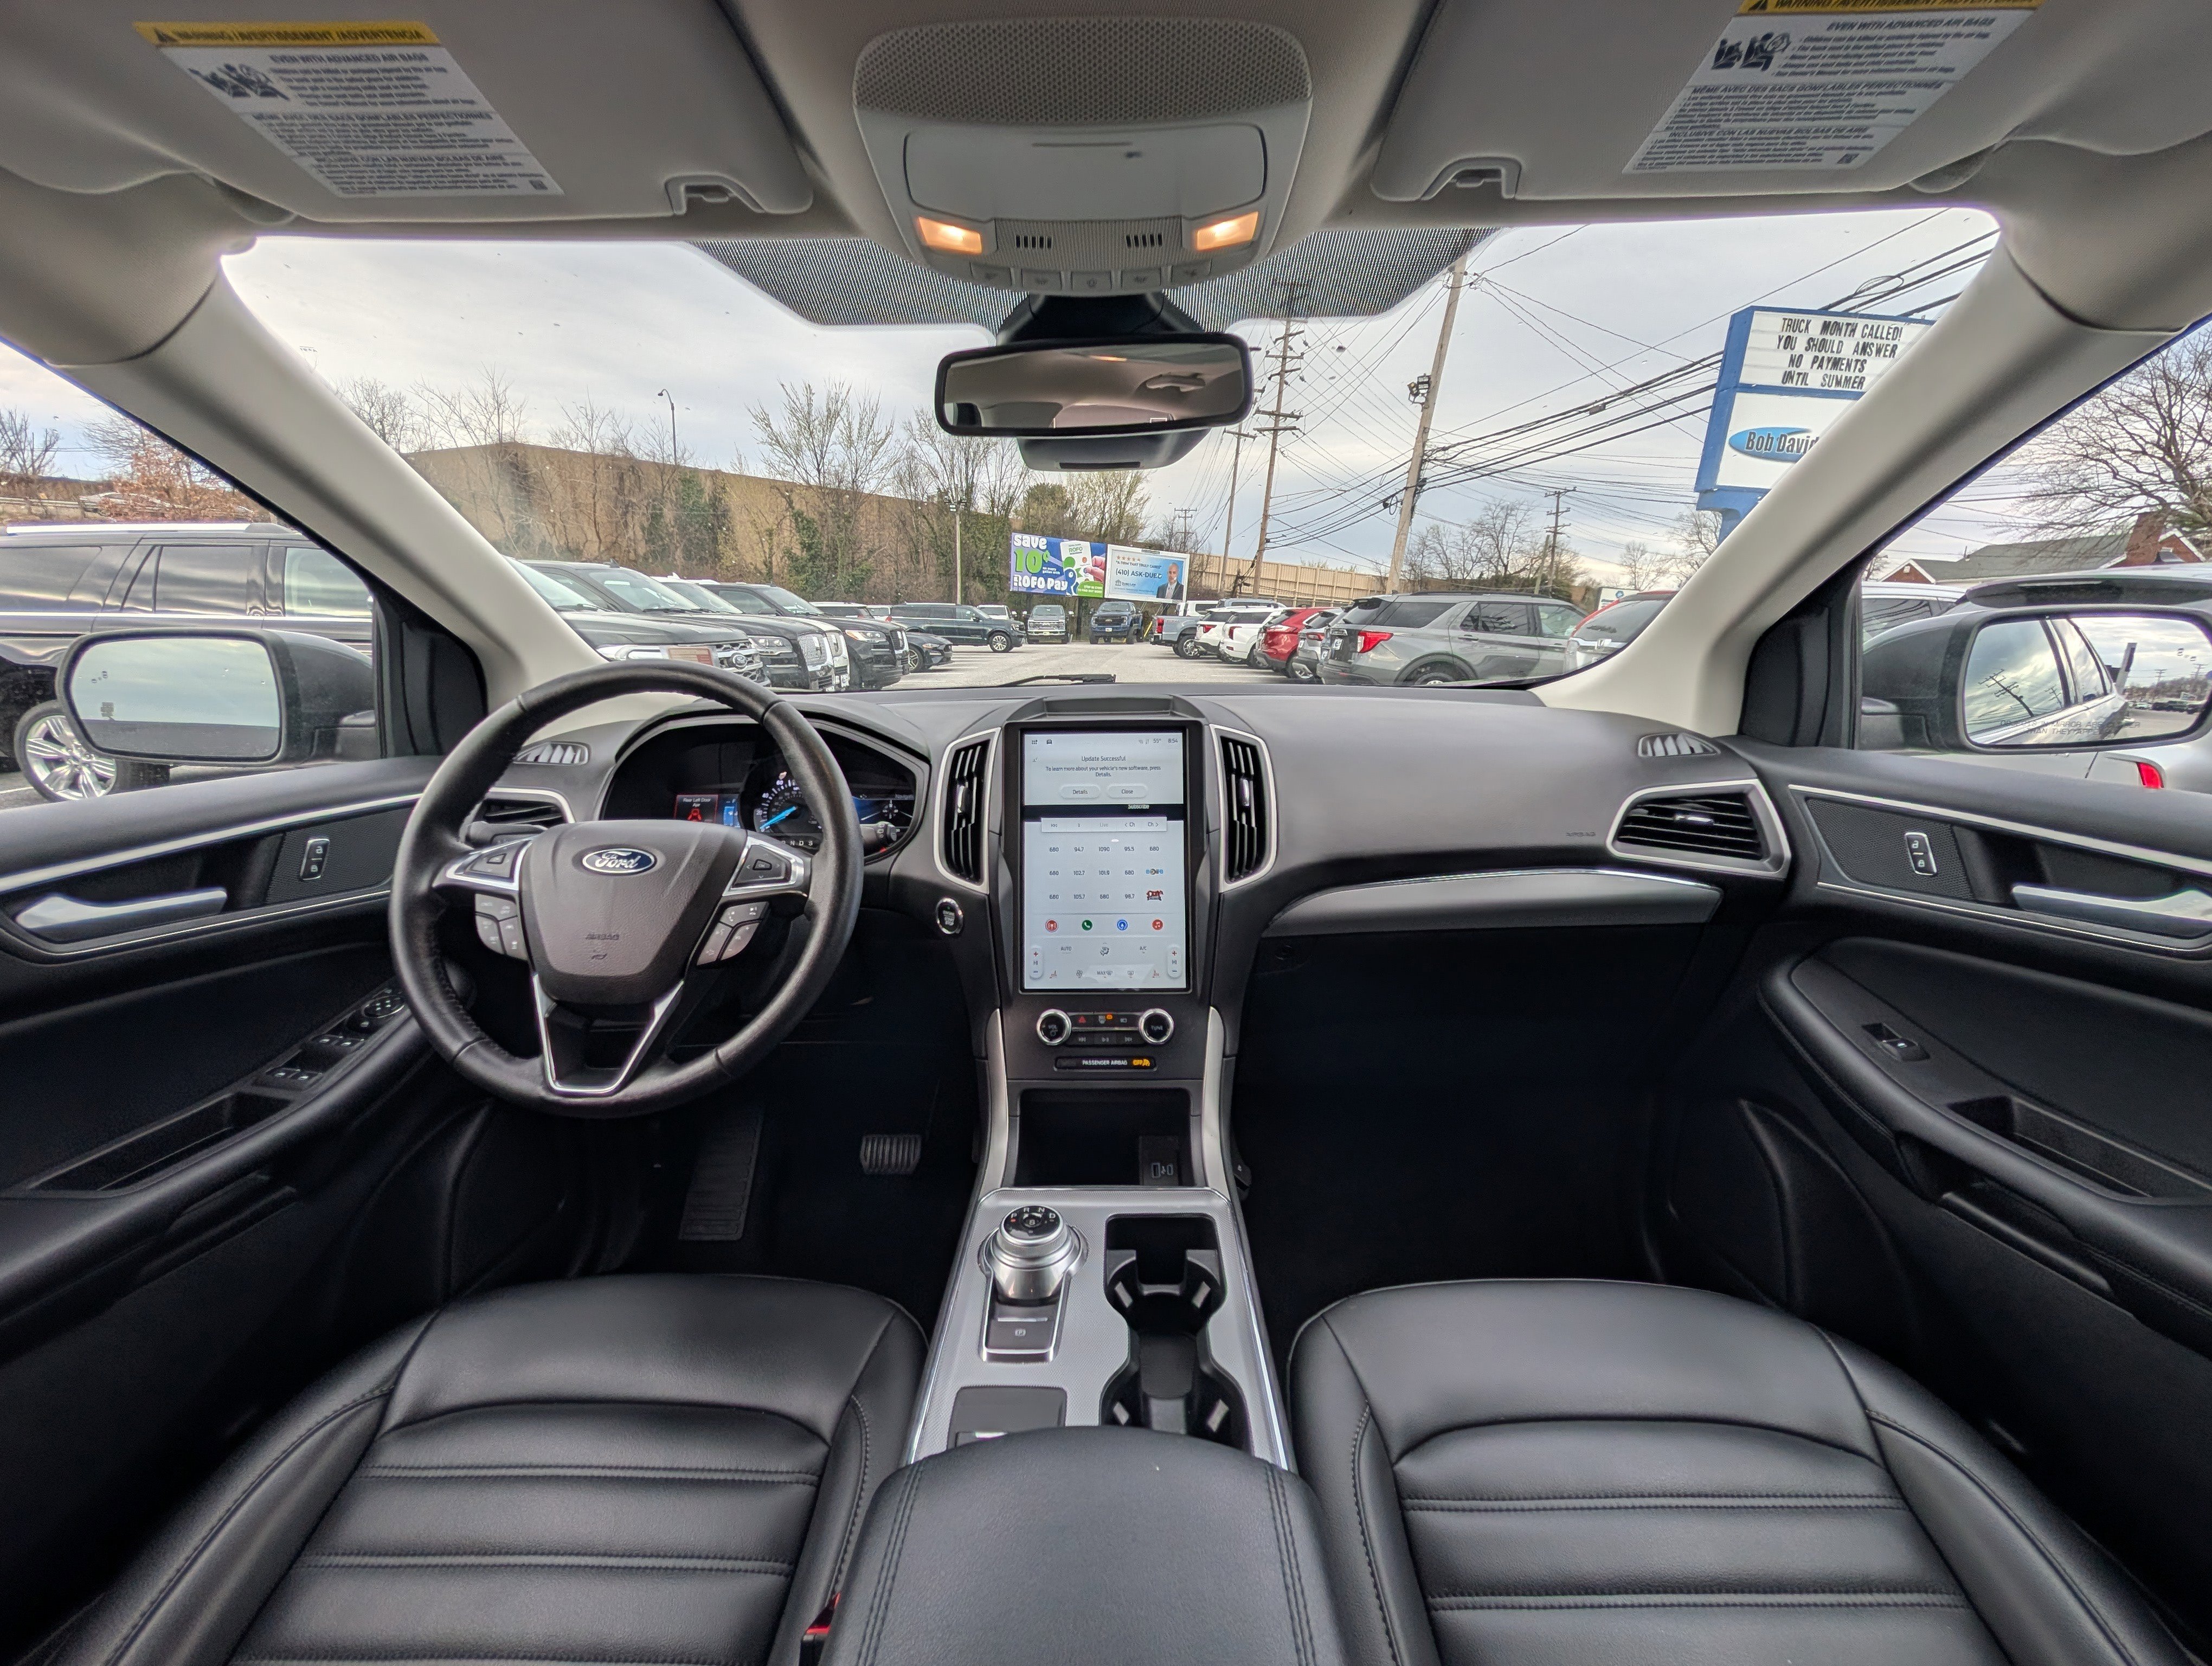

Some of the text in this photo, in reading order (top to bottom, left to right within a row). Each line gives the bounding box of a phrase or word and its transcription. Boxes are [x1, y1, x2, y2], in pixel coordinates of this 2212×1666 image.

[1825, 22, 1859, 30] EVEN
[1856, 21, 1887, 30] WITH
[1883, 18, 1945, 29] ADVANCED
[1961, 17, 1997, 27] BAGS
[1781, 318, 1902, 341] TRUCK MONTH CALLED!
[1777, 335, 1898, 358] YOU SHOULD ANSWER
[1788, 354, 1867, 373] NO PAYMENTS
[1782, 370, 1866, 389] UNTIL SUMMER
[1746, 432, 1772, 453] Bob
[1013, 574, 1046, 589] ROFO
[1116, 568, 1129, 576] (410)
[595, 851, 641, 868] Ford
